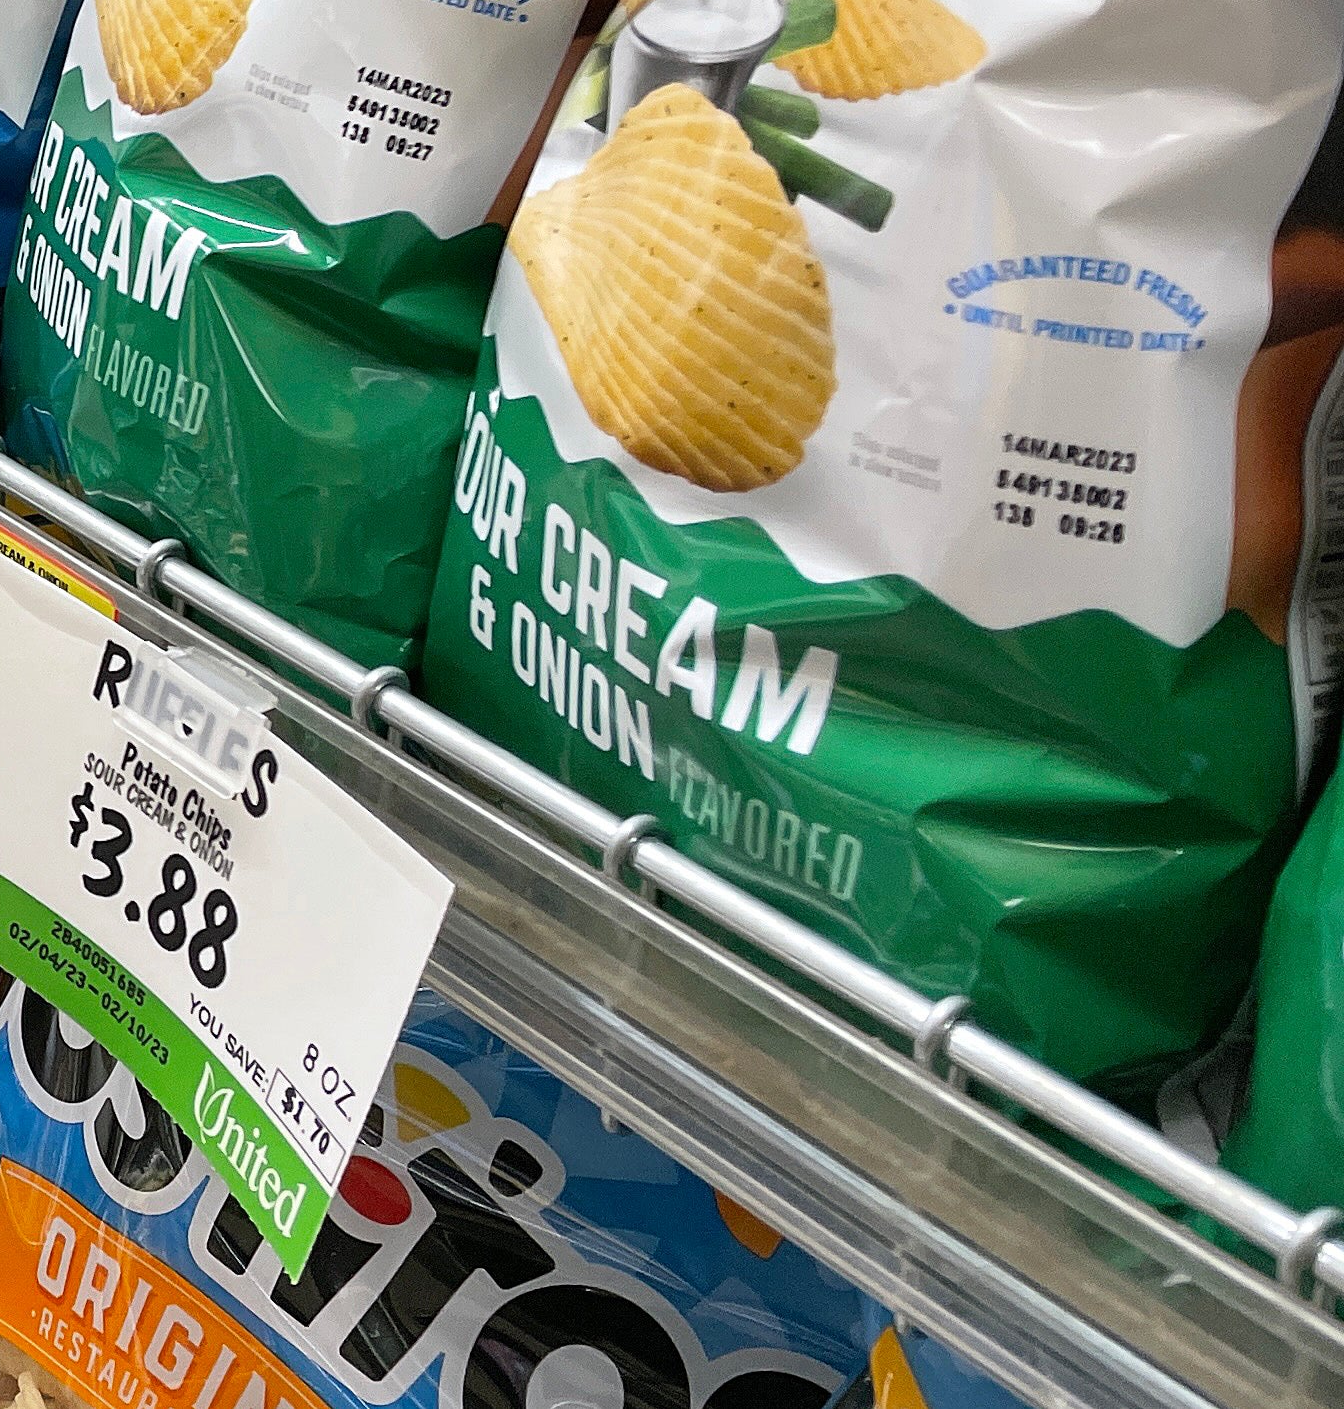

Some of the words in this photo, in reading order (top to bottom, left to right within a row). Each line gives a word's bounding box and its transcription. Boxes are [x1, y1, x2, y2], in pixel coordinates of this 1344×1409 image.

[356, 66, 453, 108] 14MAR2023
[54, 145, 207, 321] CREAM
[946, 255, 1131, 300] GUARANTEED
[1134, 268, 1208, 328] FRESH
[14, 216, 34, 284] &
[28, 231, 93, 358] ONION
[85, 325, 210, 436] FLAVORED
[962, 303, 1024, 334] UNTIL
[1032, 318, 1135, 350] PRINTED
[1139, 331, 1192, 352] DATE
[1001, 432, 1138, 475] 14MAR2023
[544, 499, 839, 756] CREAM
[469, 563, 495, 651] &
[511, 608, 656, 782] ONION
[667, 743, 865, 902] FLAVORED
[83, 752, 126, 802] SOUR
[126, 781, 176, 835] CREAM
[188, 831, 235, 882] ONION
[120, 741, 179, 808] Potato
[181, 788, 233, 852] Chips
[69, 781, 240, 989] $3.88
[8, 922, 86, 990] 02/04/23
[100, 994, 170, 1066] 02/10/23
[189, 992, 224, 1039] YOU
[225, 1034, 269, 1094] SAVE:
[302, 1043, 319, 1072] 8
[192, 1060, 307, 1239] United
[281, 1087, 330, 1154] $1.70
